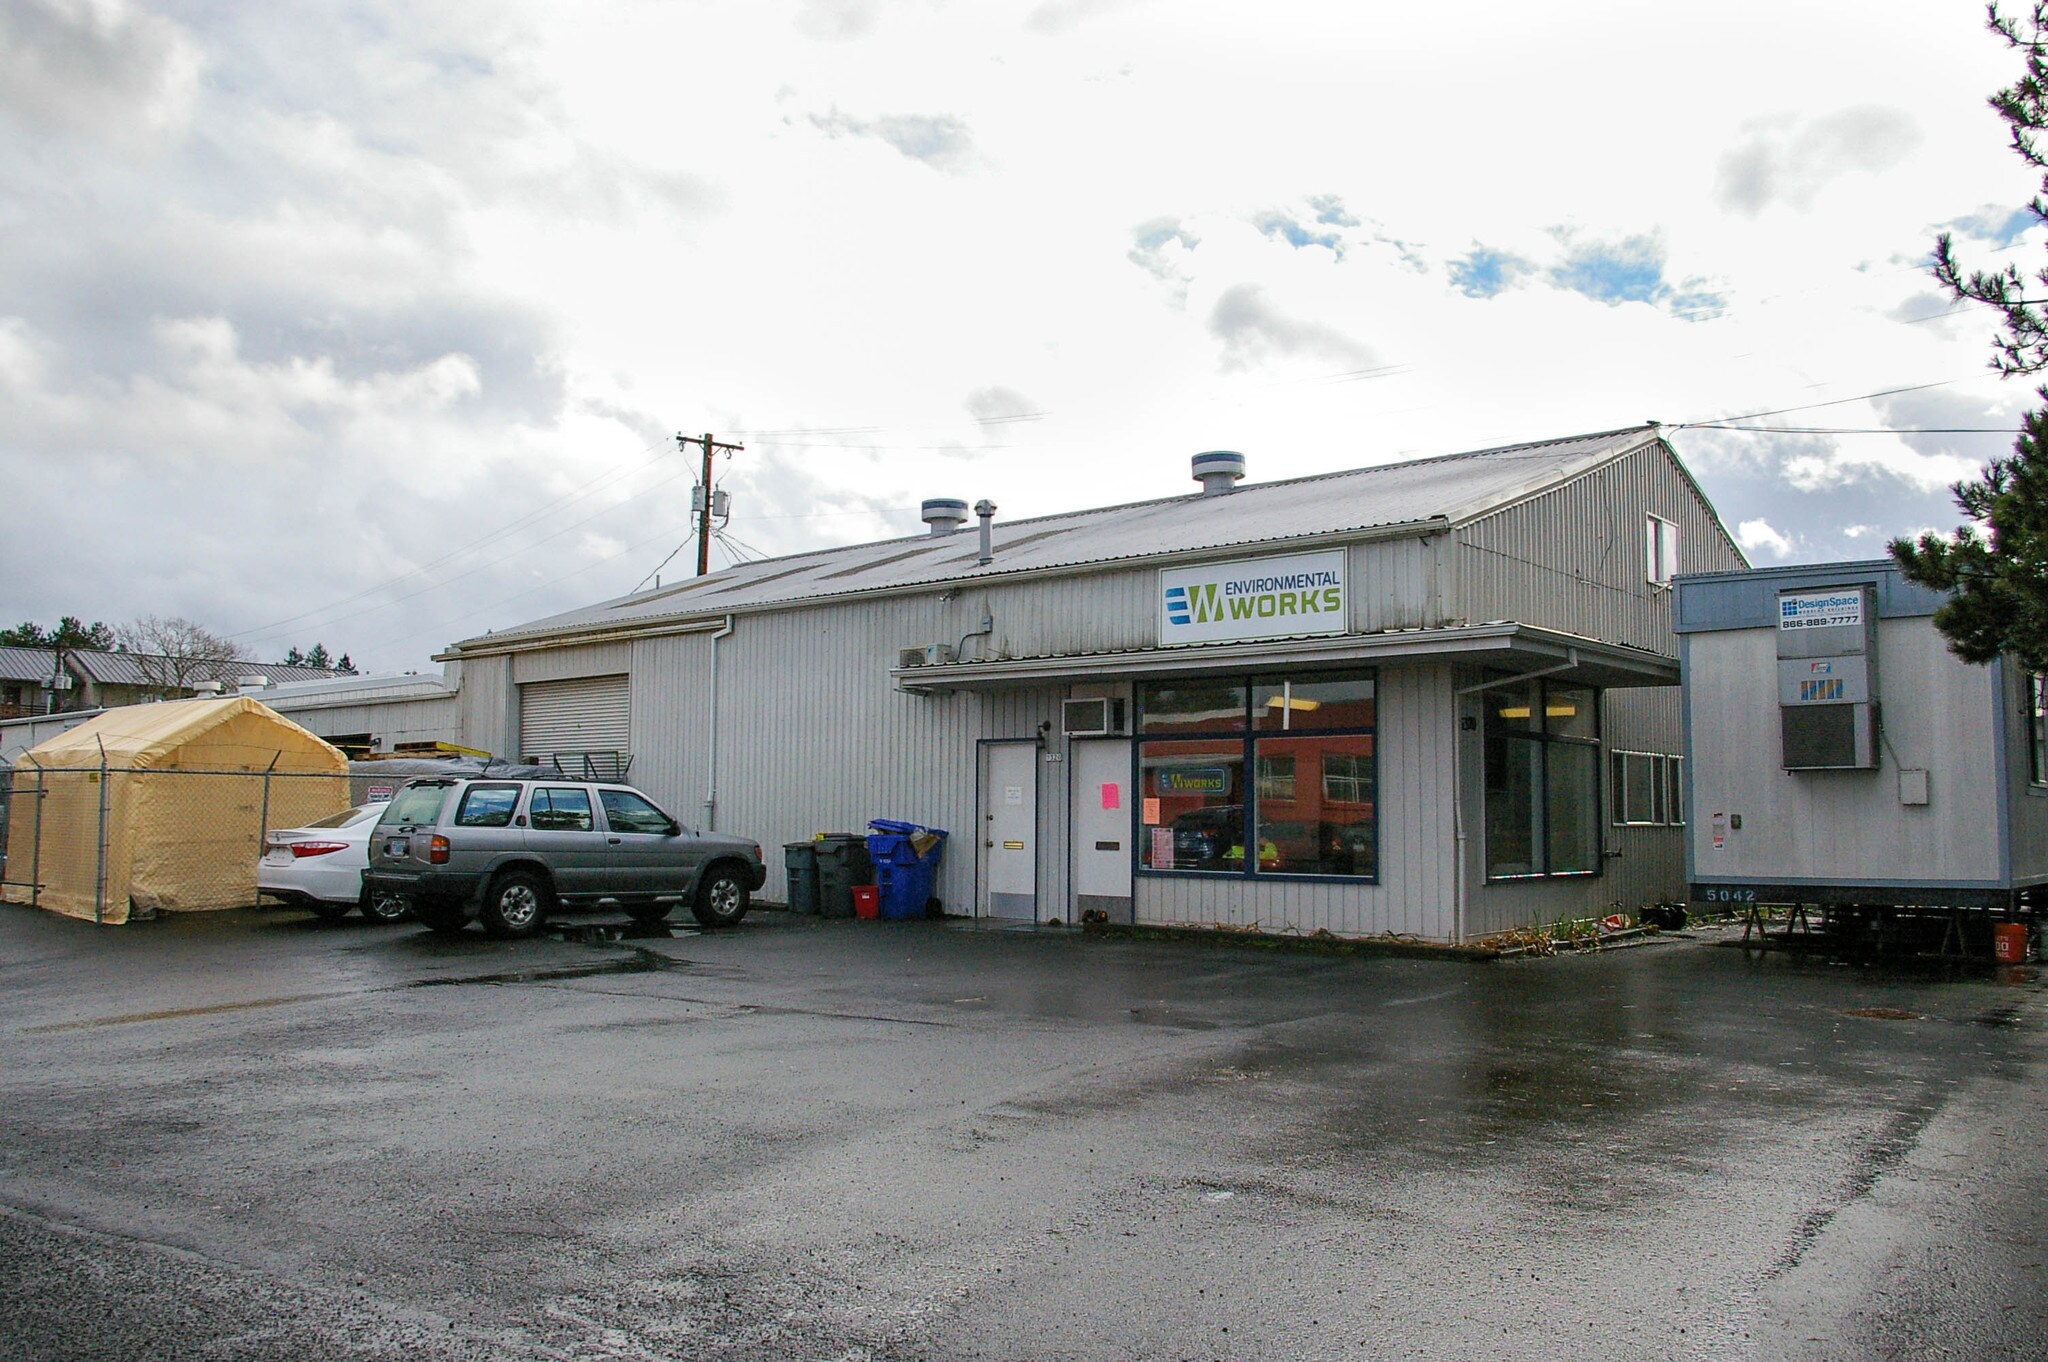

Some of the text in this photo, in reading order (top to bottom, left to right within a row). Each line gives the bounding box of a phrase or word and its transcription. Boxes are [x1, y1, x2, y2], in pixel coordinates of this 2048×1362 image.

[1225, 571, 1340, 595] ENVIRONMENTAL
[1229, 587, 1341, 620] WORKS
[1798, 596, 1859, 609] DesignSpace
[1782, 615, 1859, 629] 866-889-7777
[1184, 778, 1221, 788] WORKS
[1706, 889, 1755, 901] 5042
